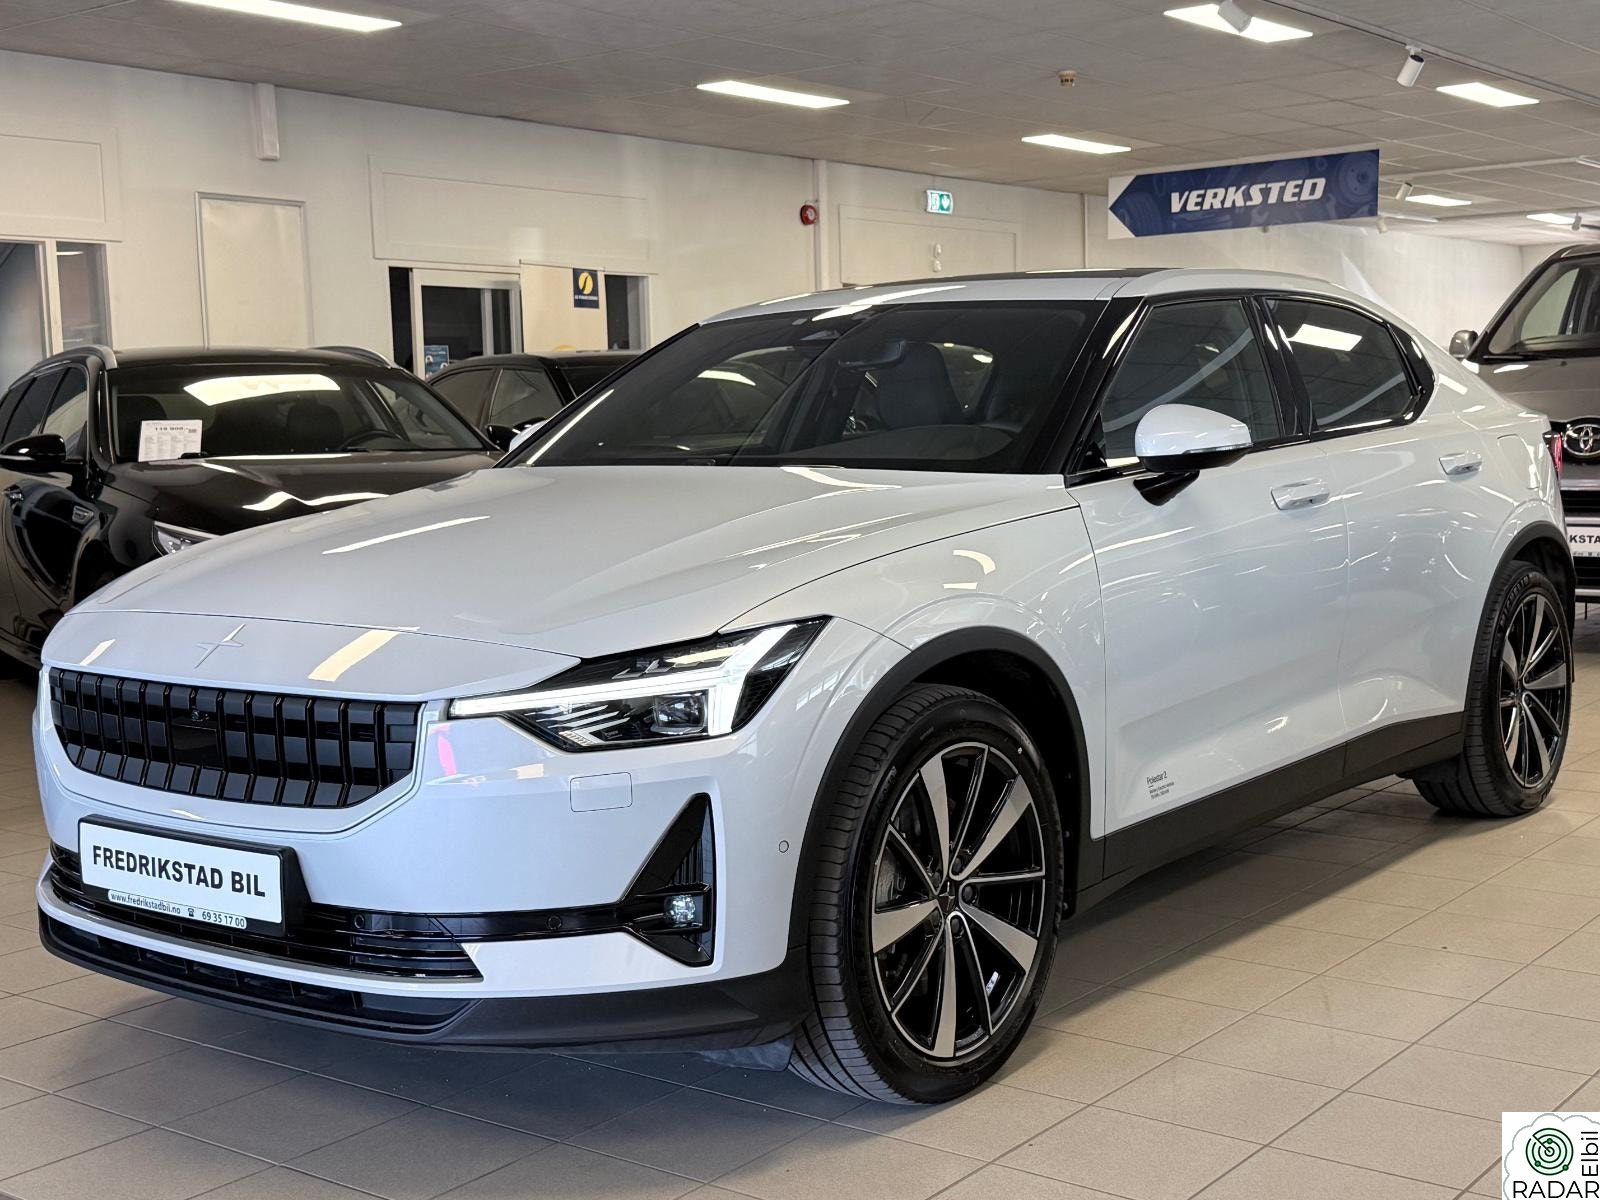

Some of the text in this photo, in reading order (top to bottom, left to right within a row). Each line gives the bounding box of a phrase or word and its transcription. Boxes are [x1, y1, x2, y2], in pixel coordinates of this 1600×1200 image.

[1171, 177, 1326, 213] VERKSTED
[93, 845, 266, 897] FREDRIKSTAD BIL
[110, 893, 245, 928] www.fredrikstadbil.no 69 35 17 00
